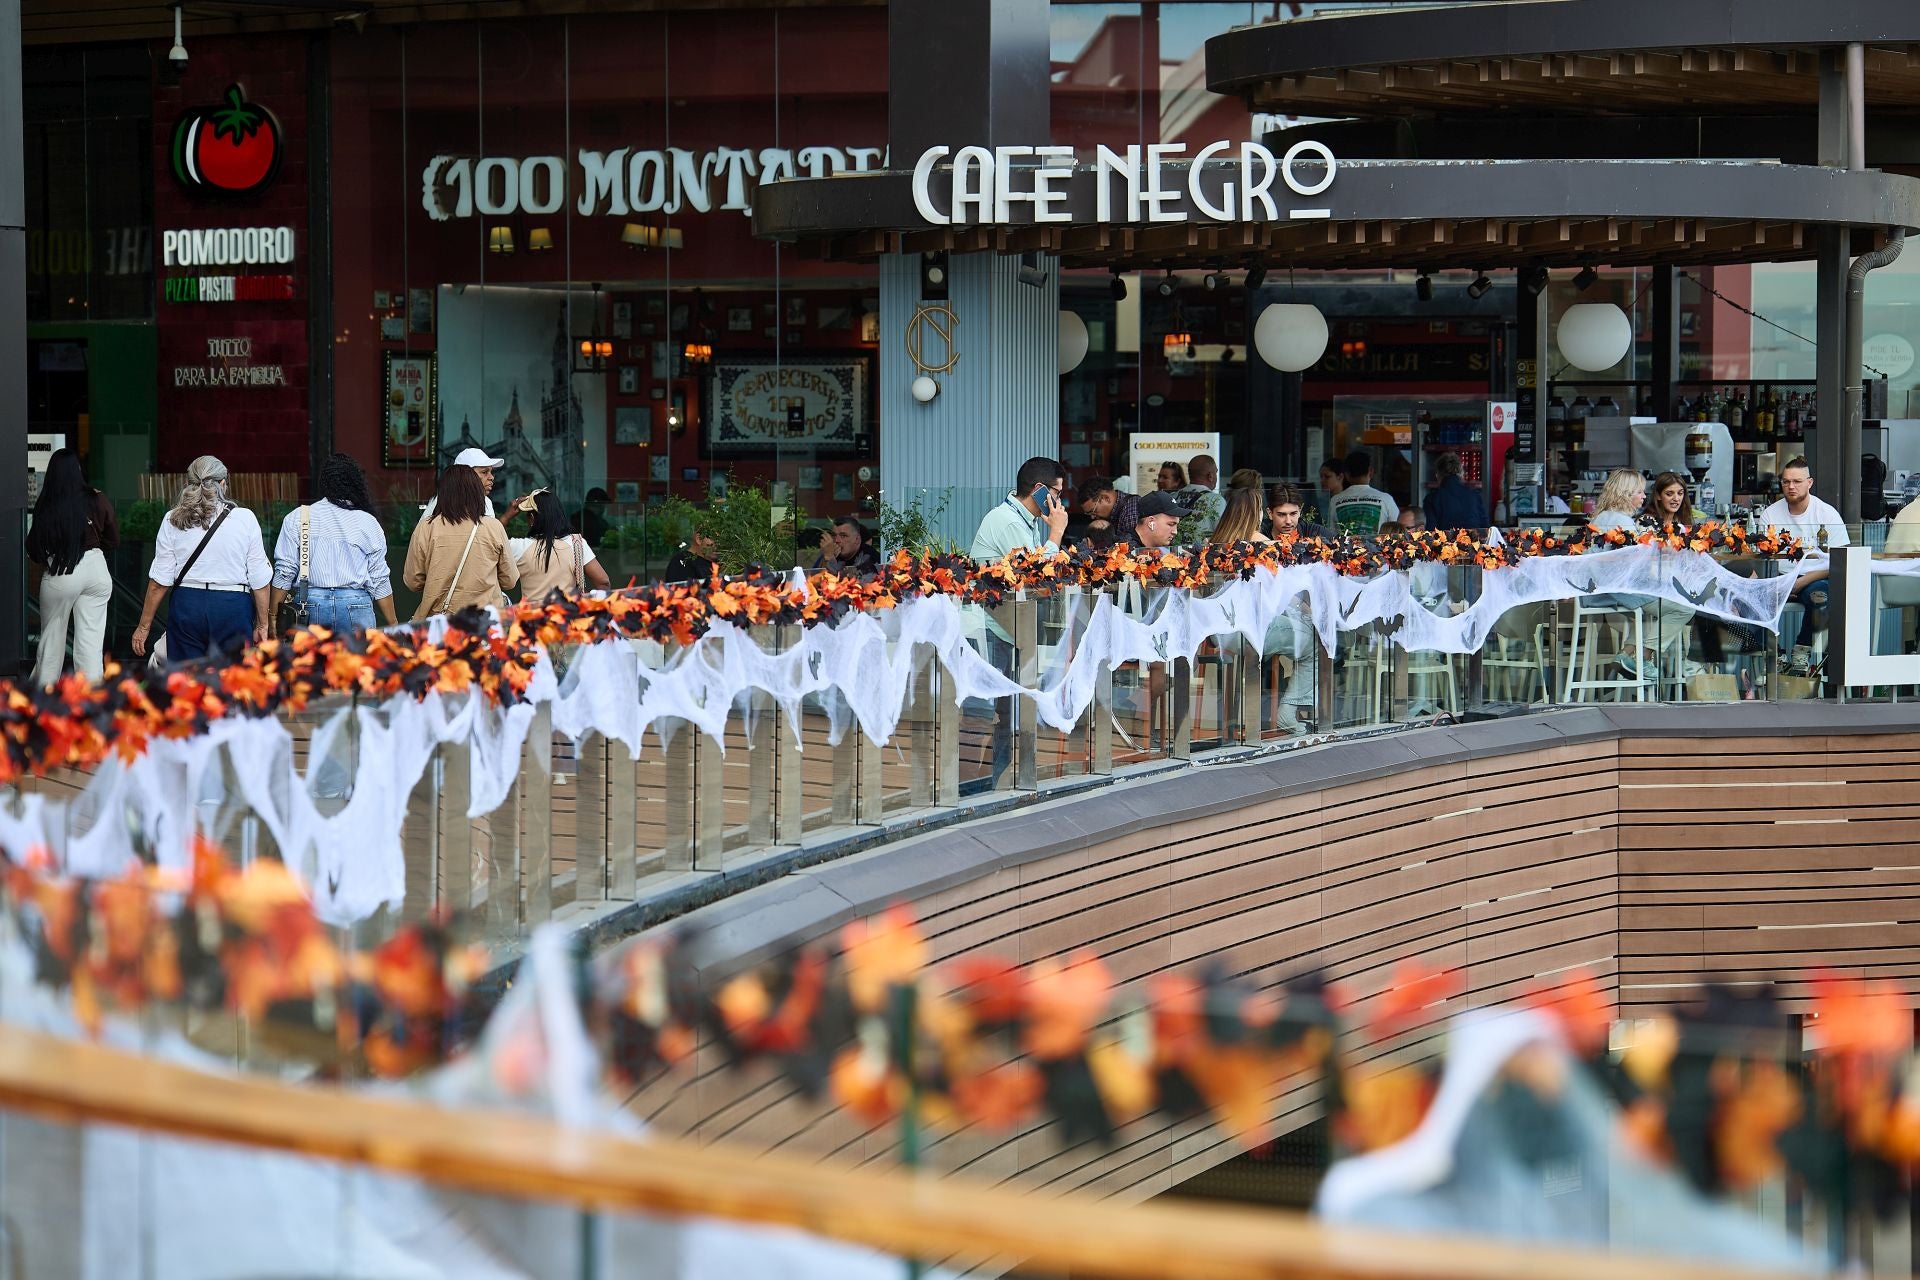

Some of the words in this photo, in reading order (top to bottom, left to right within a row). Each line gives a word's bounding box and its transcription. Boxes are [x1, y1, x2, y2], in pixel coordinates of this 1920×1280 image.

[912, 145, 1074, 224] CAFE
[1097, 140, 1337, 223] NEGRO
[163, 226, 295, 266] POMODORO
[165, 277, 198, 303] PIZZA
[199, 275, 236, 302] PASTA
[174, 367, 207, 386] PARA
[210, 367, 227, 385] LA
